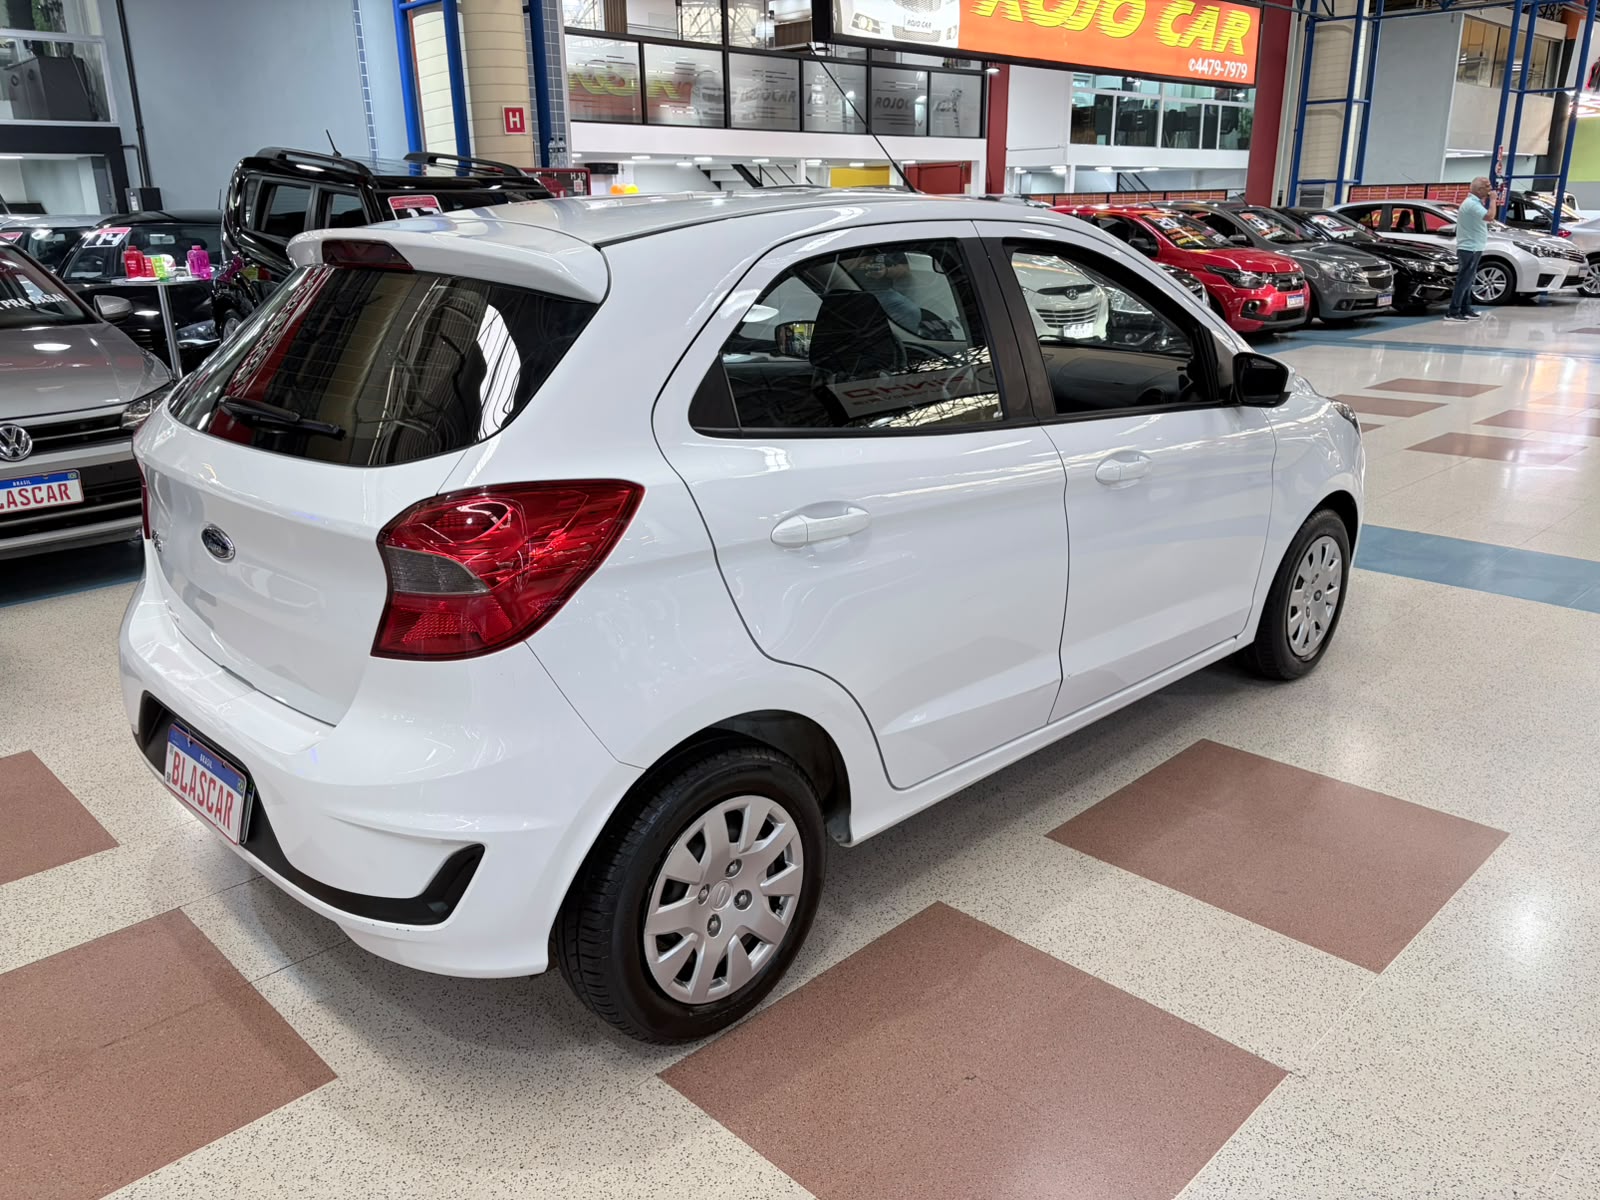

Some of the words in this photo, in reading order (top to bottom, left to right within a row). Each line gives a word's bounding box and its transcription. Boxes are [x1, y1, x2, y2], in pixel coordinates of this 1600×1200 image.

[1154, 0, 1251, 55] CAR
[1195, 58, 1248, 79] 4479-7979
[508, 111, 520, 128] H
[570, 172, 576, 180] H
[1, 297, 31, 309] PRA
[172, 751, 234, 831] BLASCAR
